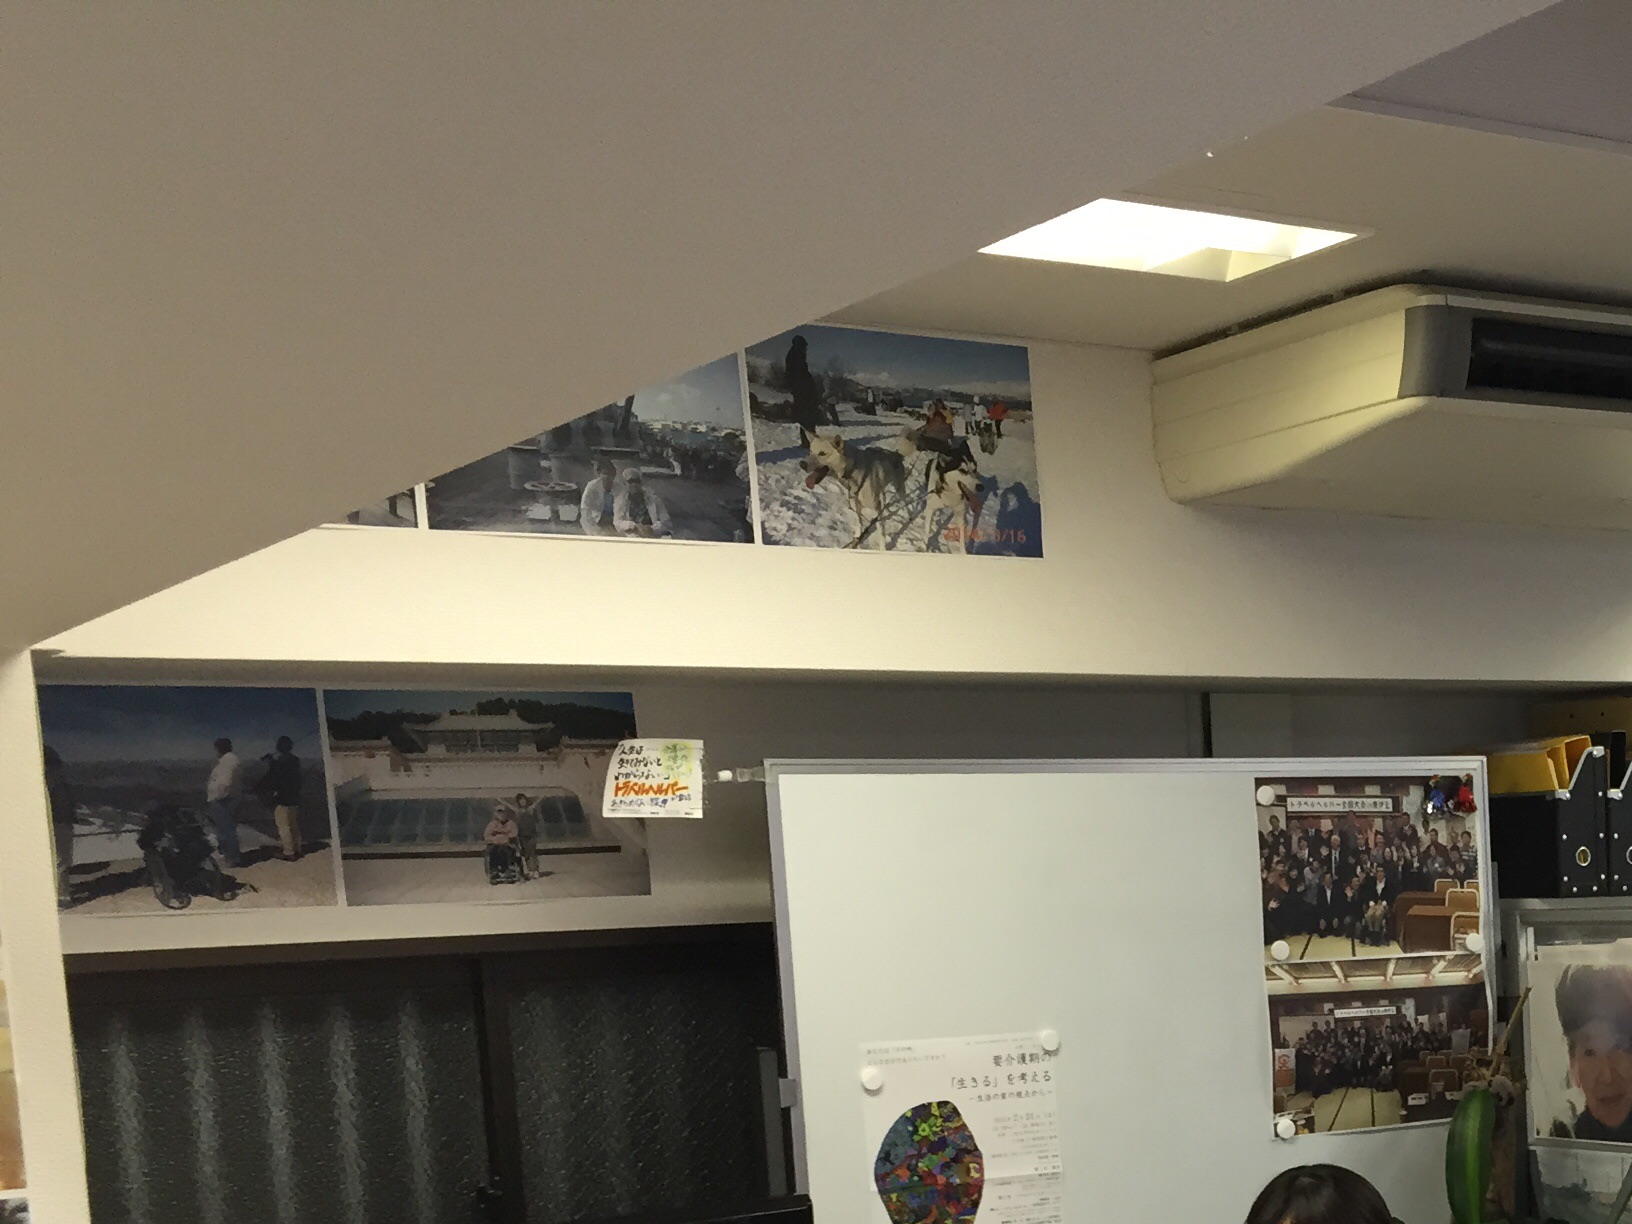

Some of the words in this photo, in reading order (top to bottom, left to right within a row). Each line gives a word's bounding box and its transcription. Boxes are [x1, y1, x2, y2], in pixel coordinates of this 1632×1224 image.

[614, 780, 689, 797] トラベルヘルパー
